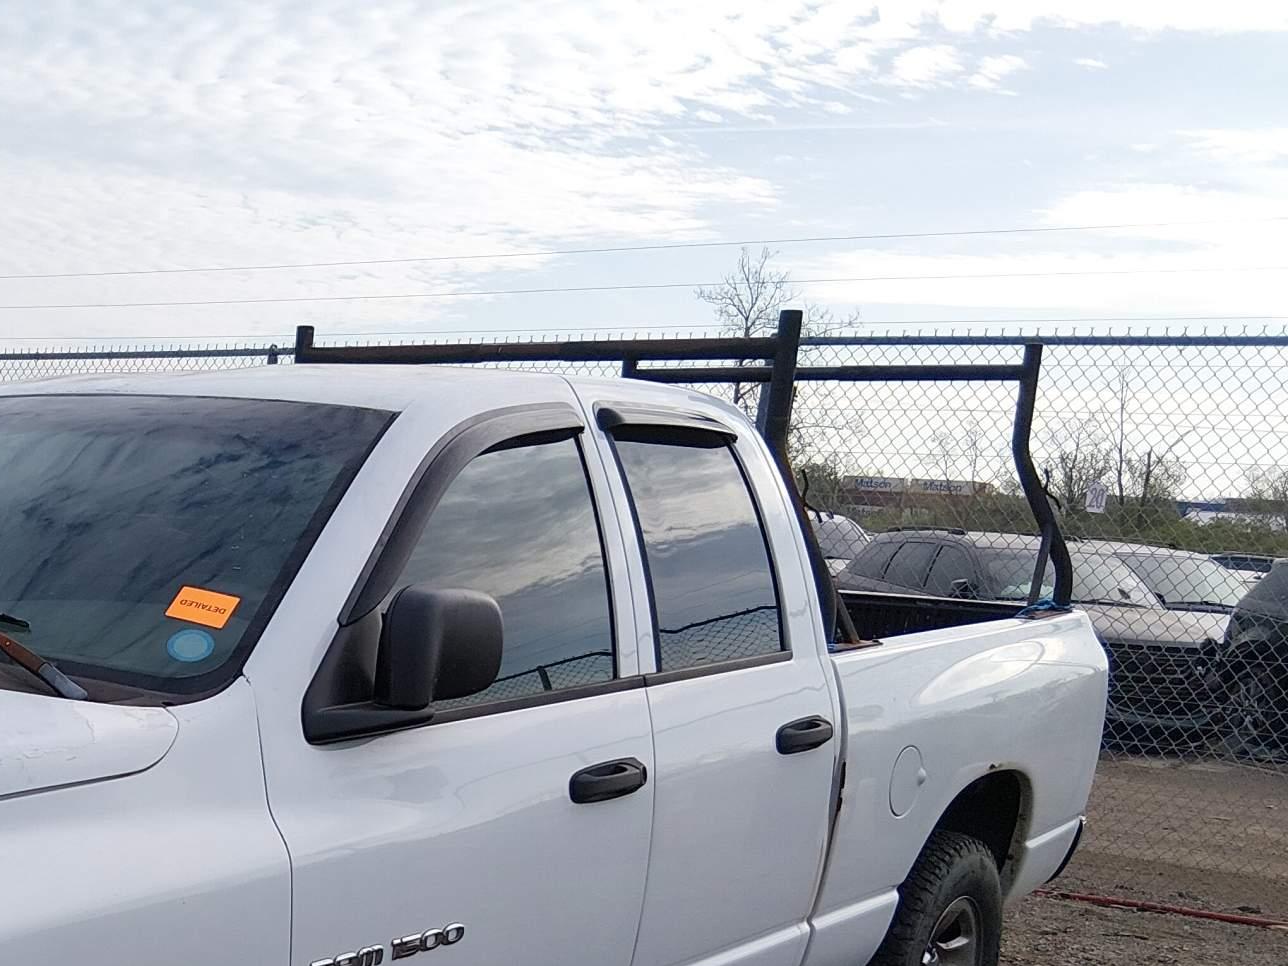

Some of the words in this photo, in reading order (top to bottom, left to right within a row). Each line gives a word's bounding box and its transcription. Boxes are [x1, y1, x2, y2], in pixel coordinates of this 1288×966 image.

[855, 478, 892, 489] Matson
[923, 480, 963, 492] Matson
[1086, 487, 1106, 509] 20
[180, 599, 226, 615] DETAILED
[391, 922, 465, 961] 1500
